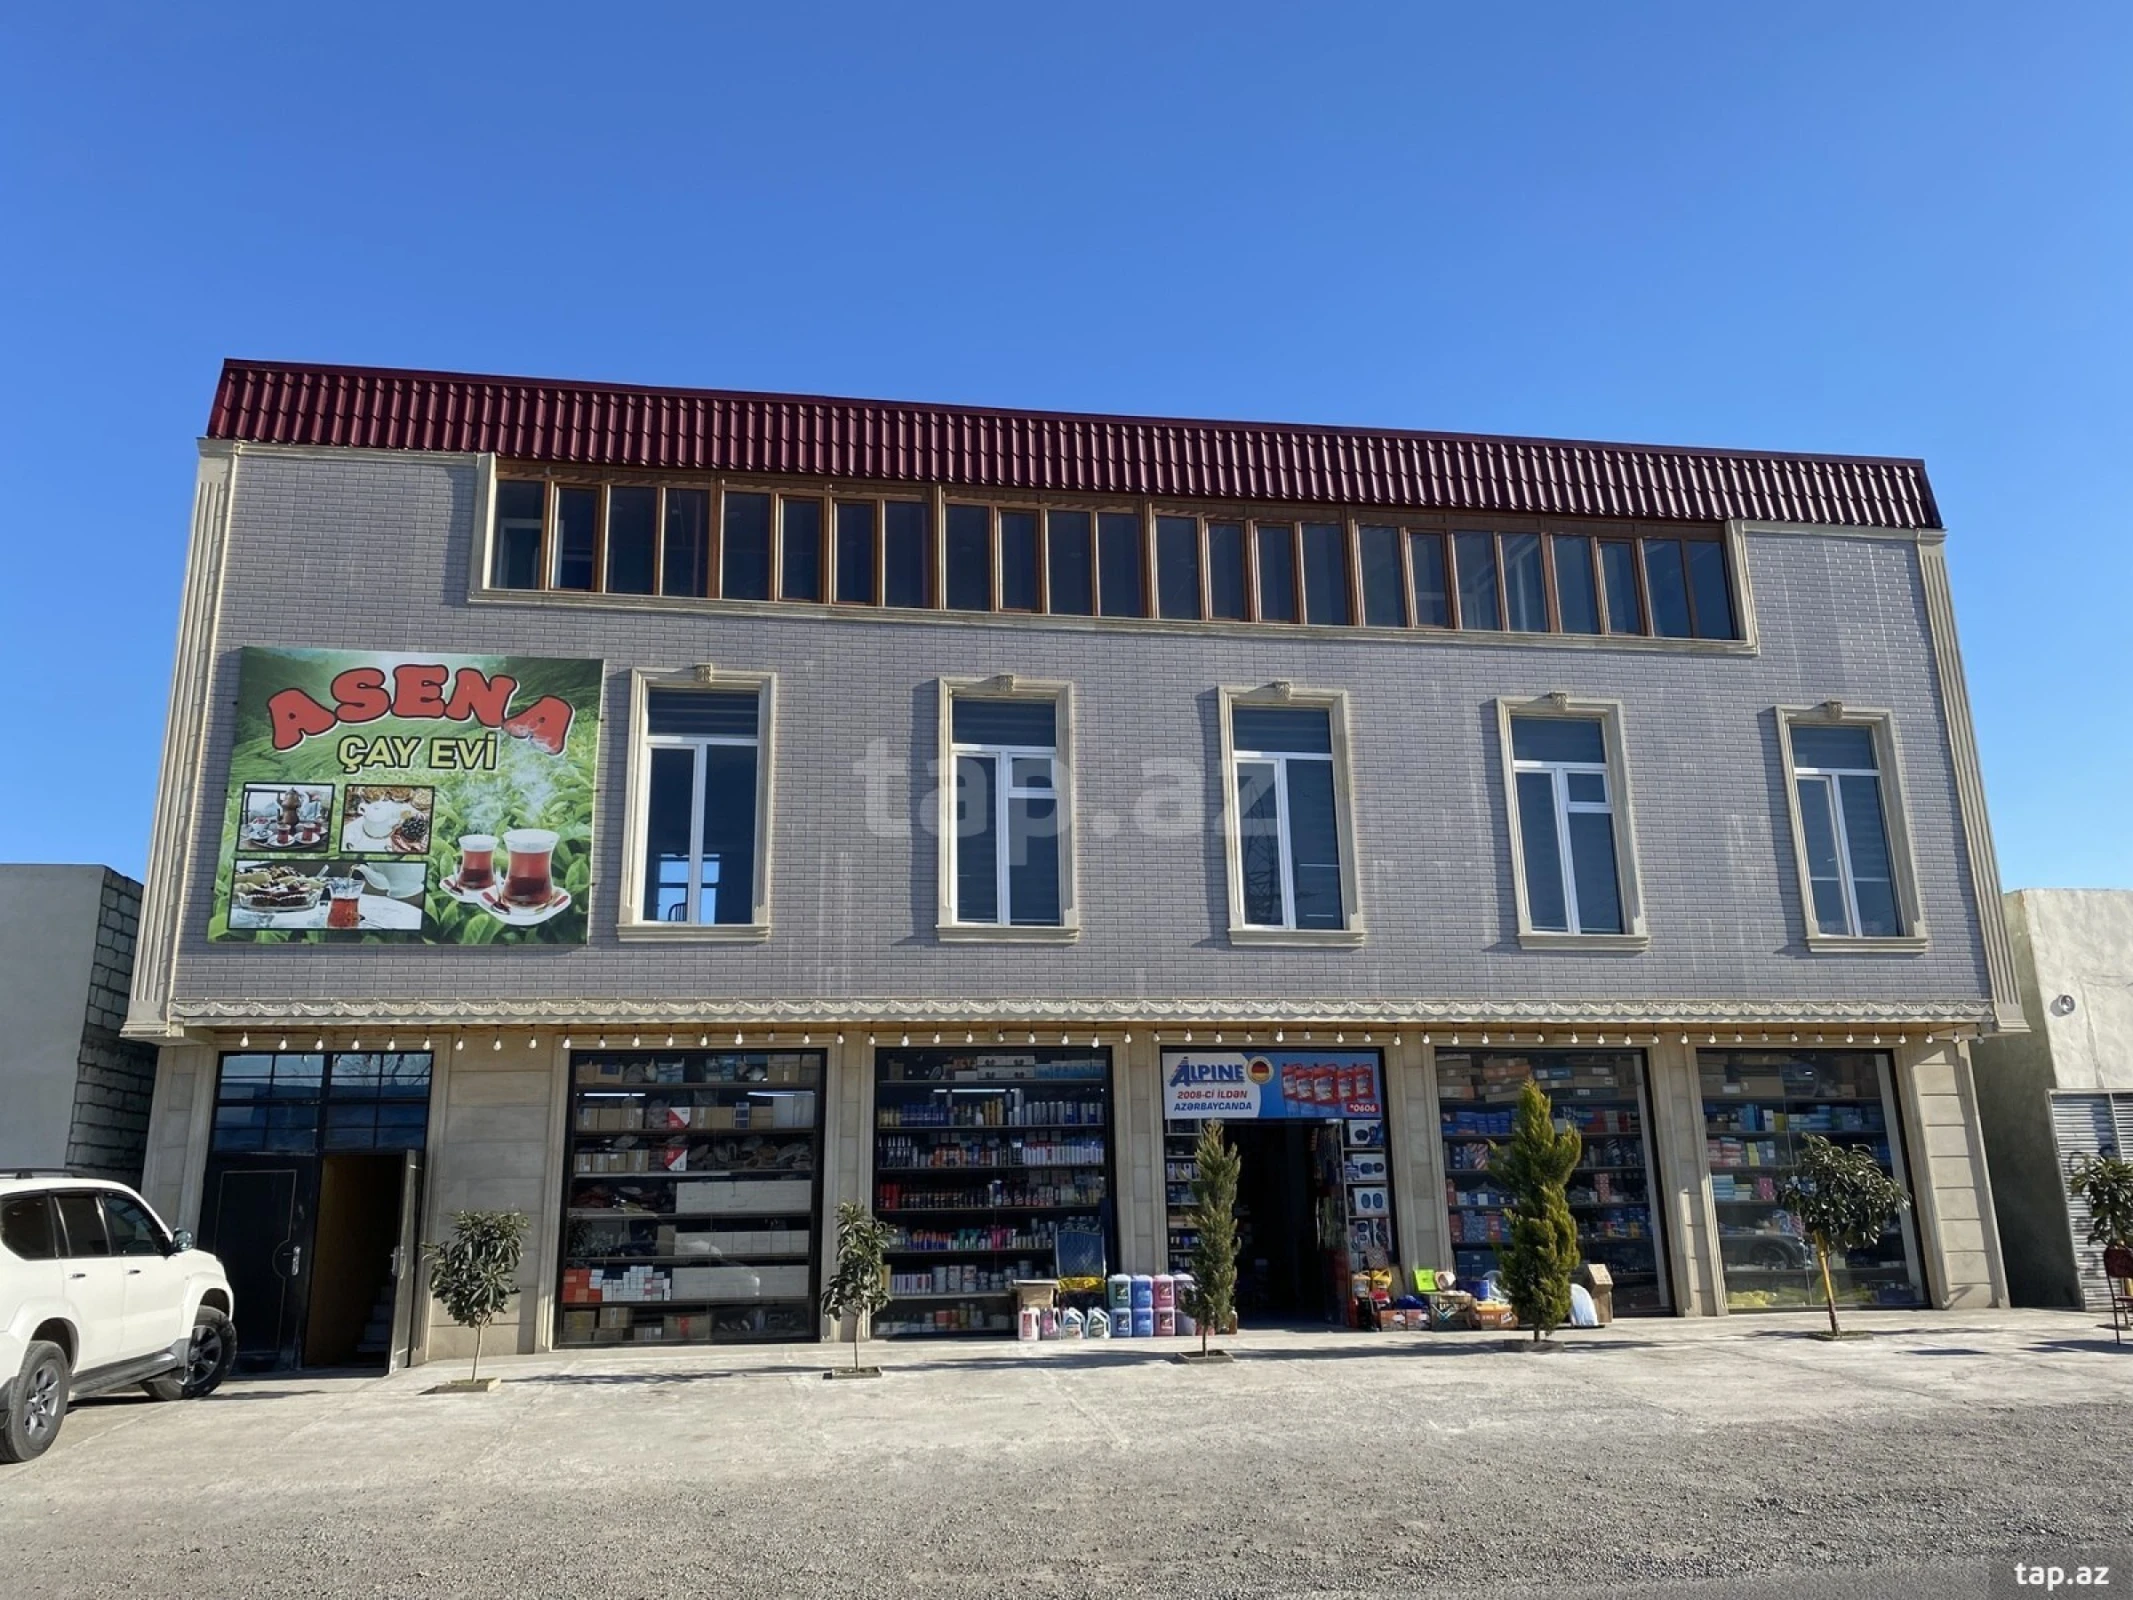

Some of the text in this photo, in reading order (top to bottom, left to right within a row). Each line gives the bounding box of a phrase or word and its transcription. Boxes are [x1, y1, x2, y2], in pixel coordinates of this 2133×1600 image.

[267, 664, 574, 754] ASENA
[339, 732, 498, 772] ÇAY EVİ
[1169, 1056, 1245, 1087] ALPINE
[1174, 1101, 1252, 1112] AZƏRBAYCANDA
